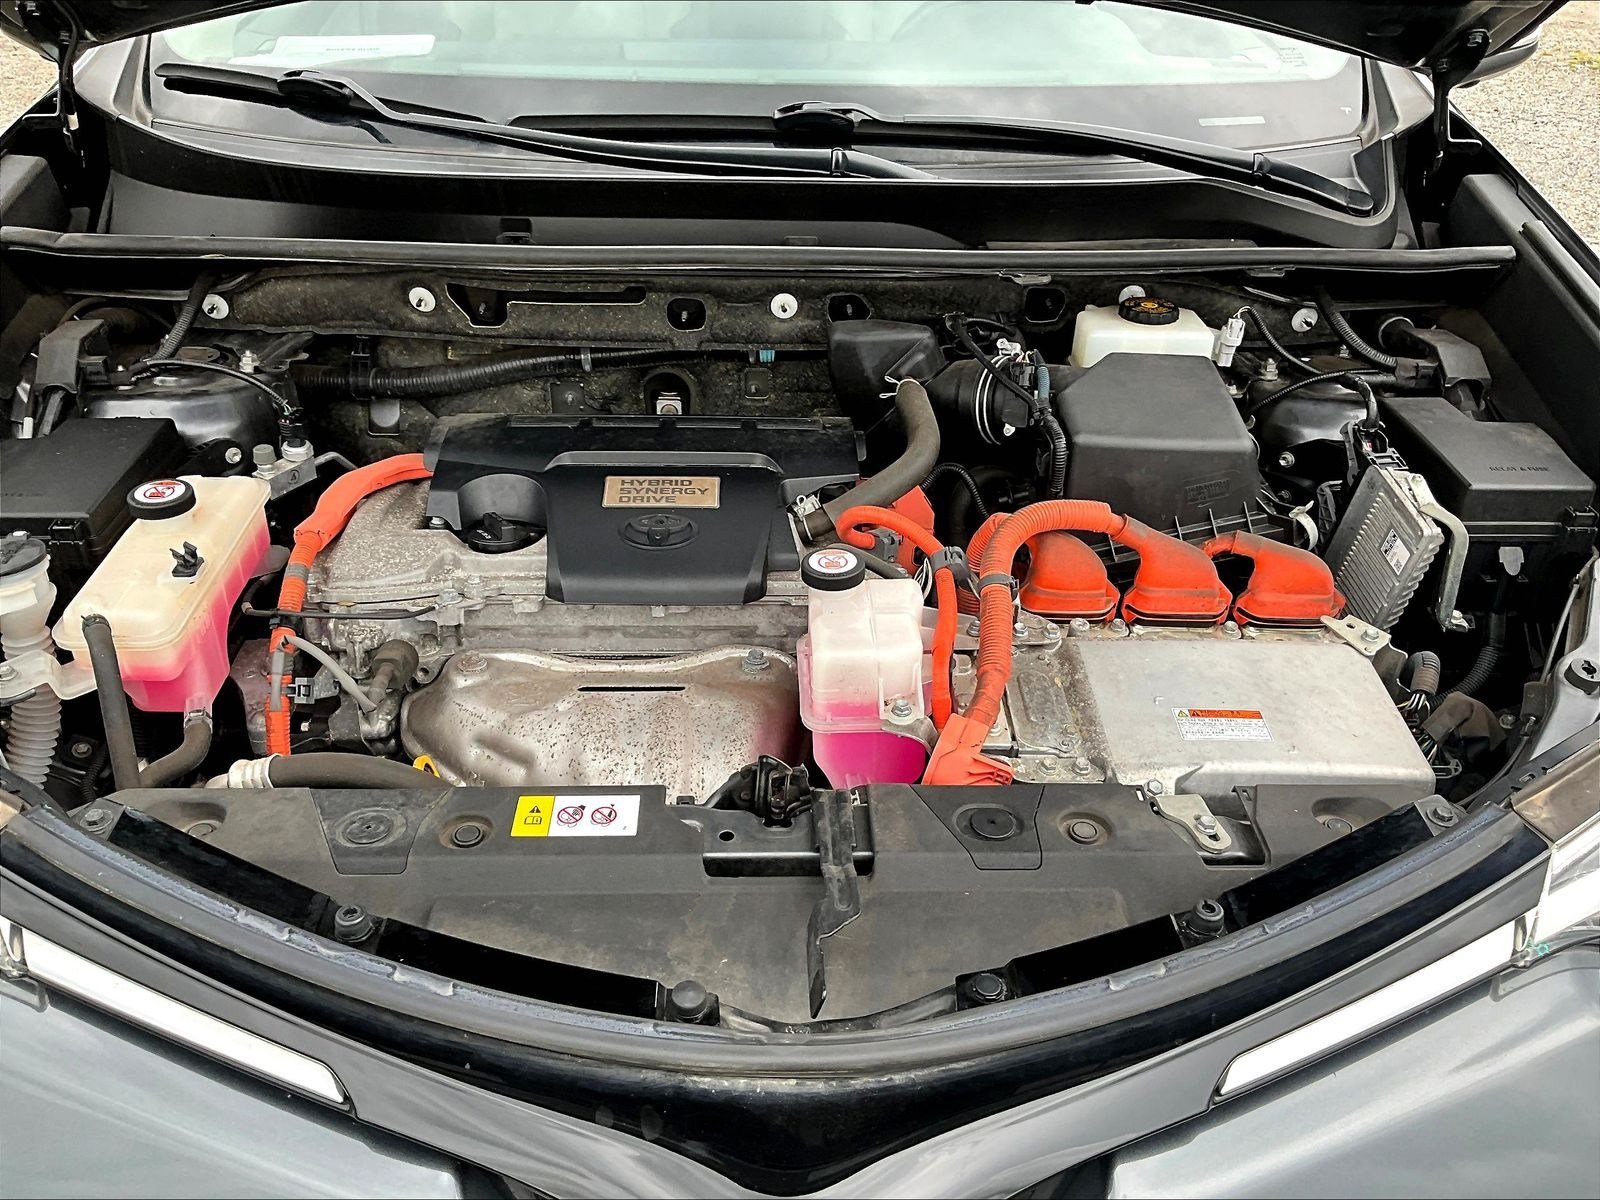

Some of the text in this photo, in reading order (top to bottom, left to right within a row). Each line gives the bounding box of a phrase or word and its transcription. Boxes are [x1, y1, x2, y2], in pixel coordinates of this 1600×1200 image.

[620, 479, 693, 487] HYBRID
[619, 487, 710, 495] SYNERGY
[618, 495, 677, 503] DRIVE
